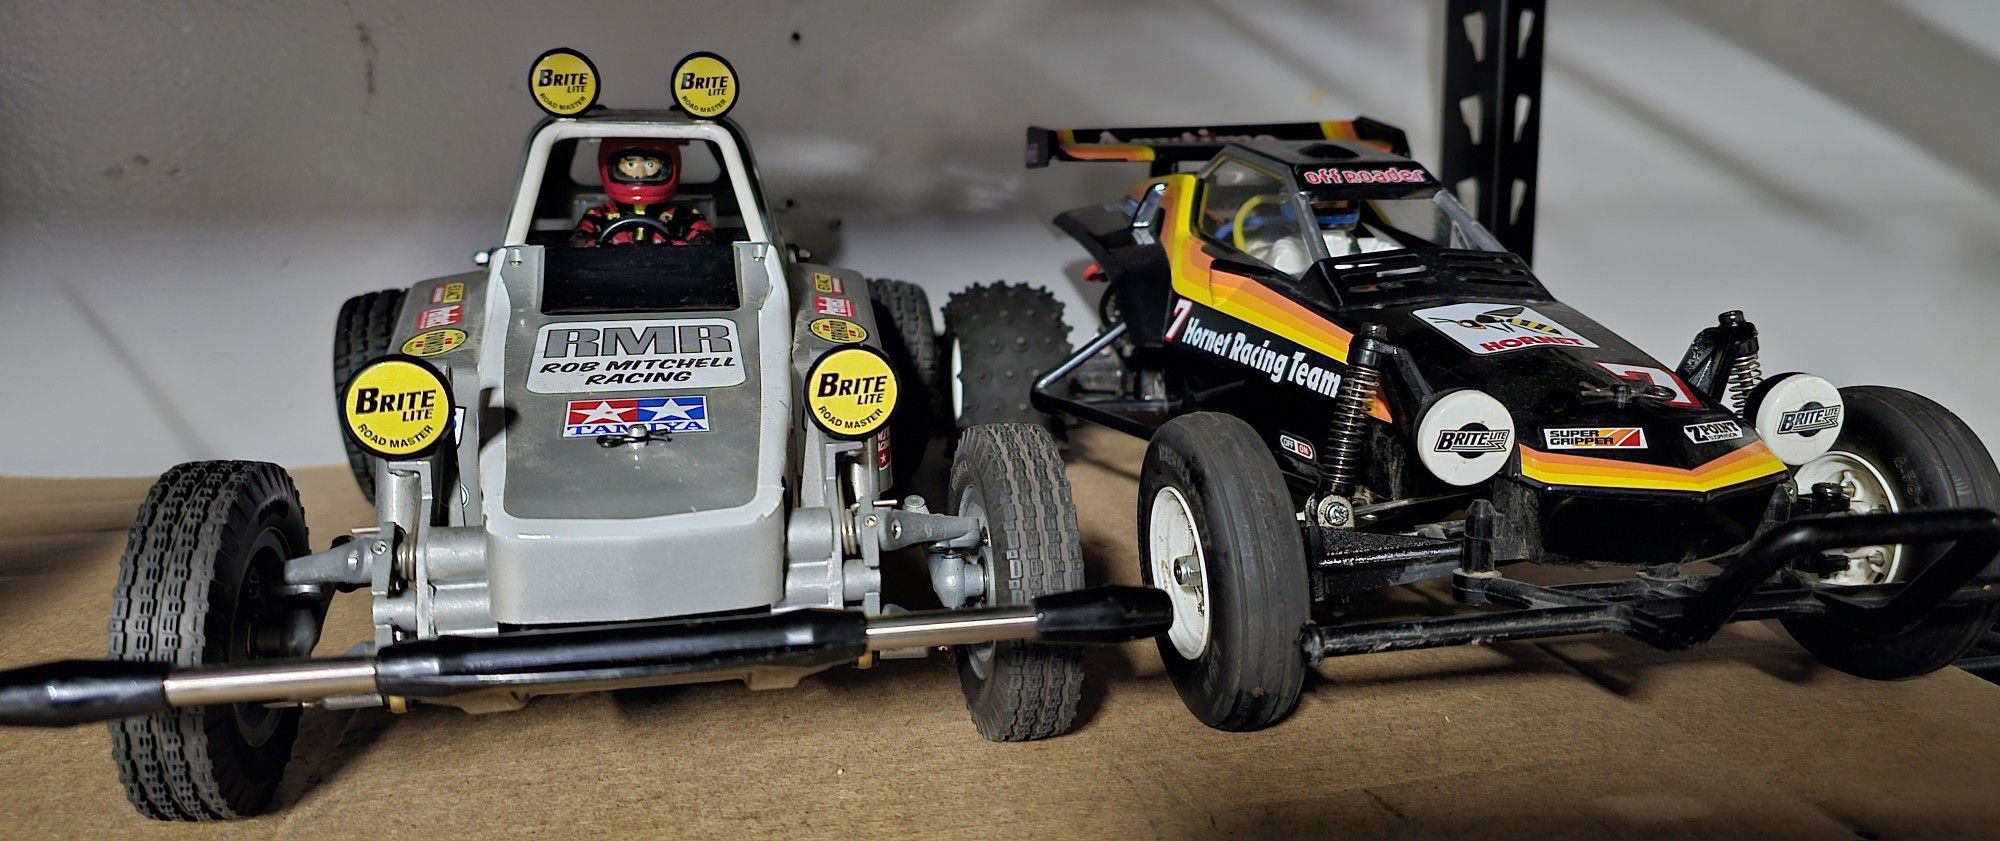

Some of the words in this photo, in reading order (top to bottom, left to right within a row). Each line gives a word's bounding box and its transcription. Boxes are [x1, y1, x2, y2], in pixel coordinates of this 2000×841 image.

[539, 69, 588, 87] BRITE
[681, 72, 728, 90] BRITE
[567, 85, 586, 93] LITE
[708, 88, 727, 96] LITE
[540, 92, 559, 110] ROAD
[559, 96, 587, 110] MASTER
[682, 95, 699, 112] ROAD
[700, 98, 727, 113] MASTER
[1163, 297, 1193, 343] 7
[543, 324, 733, 359] RMR
[1479, 335, 1584, 351] HORNET
[539, 361, 599, 374] ROB
[606, 357, 736, 372] MITCHELL
[1181, 316, 1233, 356] Hornet
[1229, 331, 1290, 384] Racing
[1287, 350, 1342, 399] Team
[584, 371, 692, 386] RACING
[817, 372, 888, 399] BRITE
[355, 387, 437, 415] BRITE
[857, 393, 885, 405] LITE
[402, 408, 434, 422] LITE
[818, 405, 842, 427] ROAD
[844, 407, 884, 429] MASTER
[1780, 410, 1824, 431] BRITE
[1824, 407, 1838, 416] LITE
[358, 423, 387, 446] ROAD
[389, 424, 435, 448] MASTER
[1437, 432, 1490, 450] BRITE
[1489, 431, 1507, 440] LITE
[1549, 429, 1600, 437] SUPER
[1550, 437, 1614, 445] GRIPPER
[1283, 438, 1294, 449] OFF
